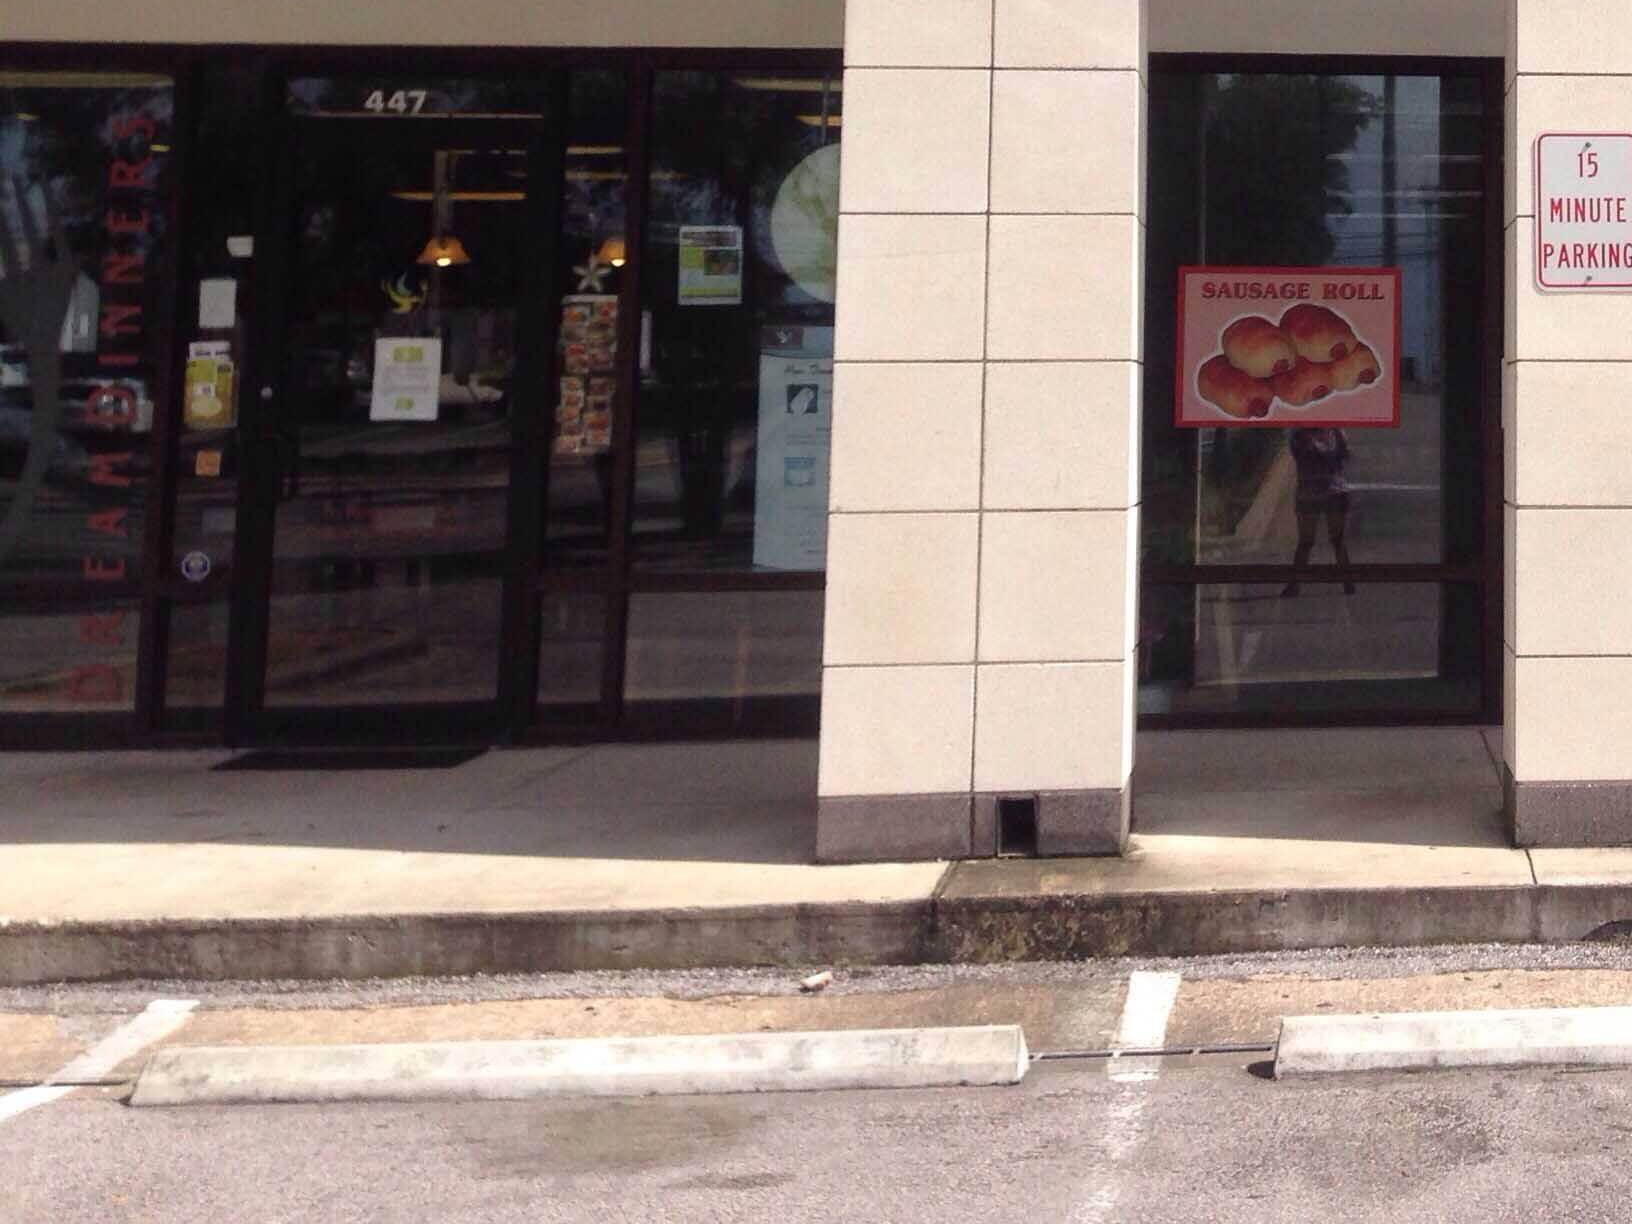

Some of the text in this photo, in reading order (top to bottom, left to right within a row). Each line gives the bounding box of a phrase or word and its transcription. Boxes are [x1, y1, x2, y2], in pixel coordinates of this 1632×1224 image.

[364, 89, 427, 116] 447
[1576, 152, 1599, 178] 15
[1549, 197, 1627, 223] MINUTE
[1201, 281, 1385, 301] SAUSAGE ROLL
